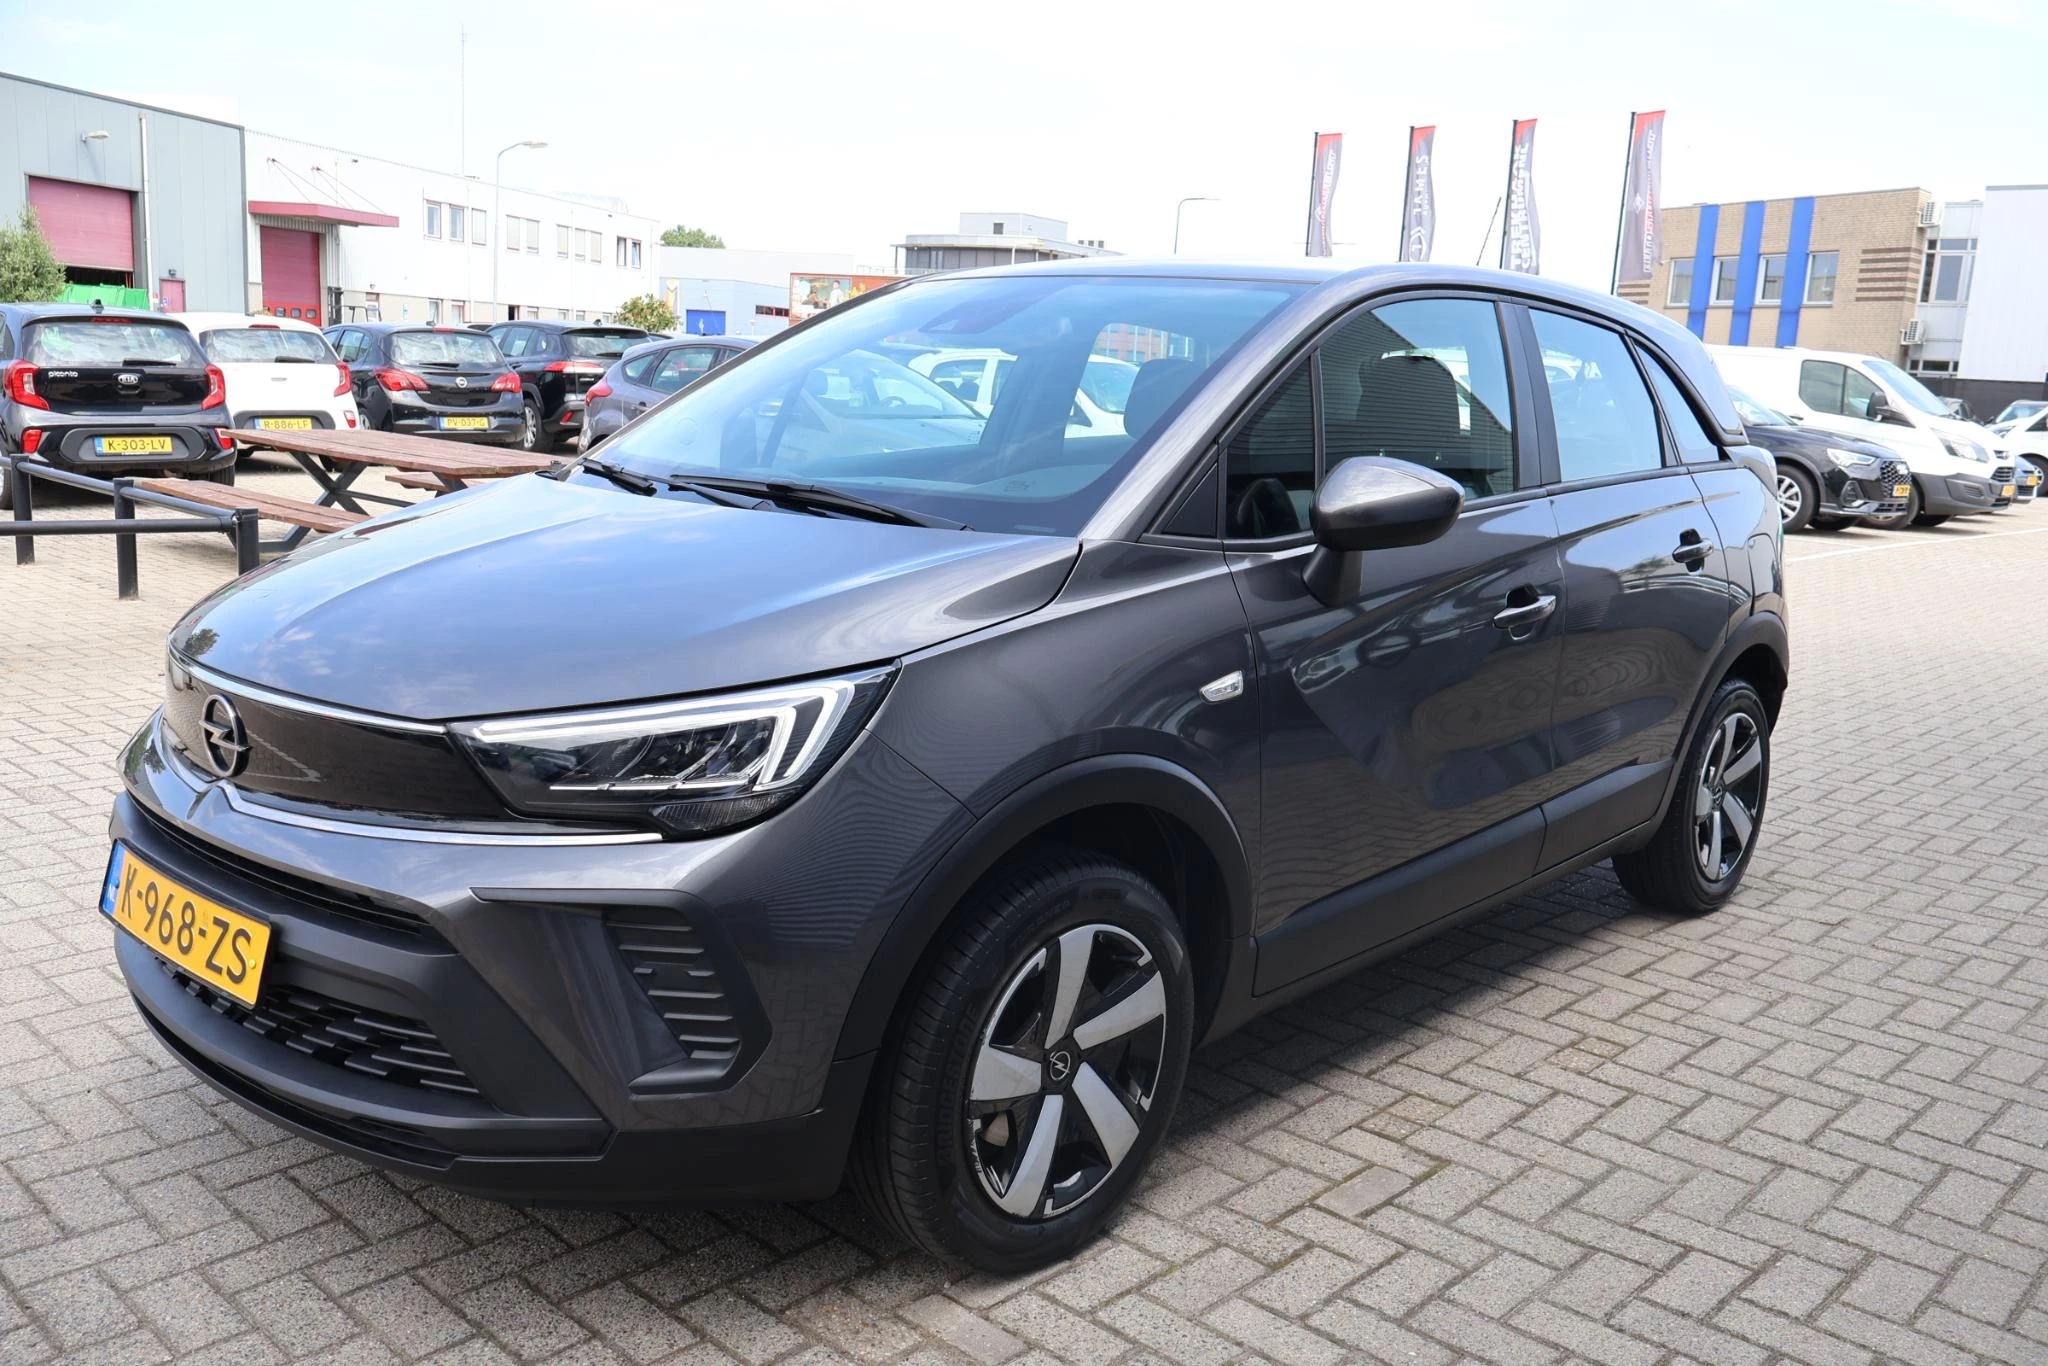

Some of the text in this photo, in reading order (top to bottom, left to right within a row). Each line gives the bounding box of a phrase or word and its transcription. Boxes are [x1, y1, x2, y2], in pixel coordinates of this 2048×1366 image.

[1414, 155, 1428, 214] JAMES
[263, 420, 308, 430] R-886-LF
[108, 437, 166, 451] K-303-LV
[121, 863, 251, 984] K-968-ZS
